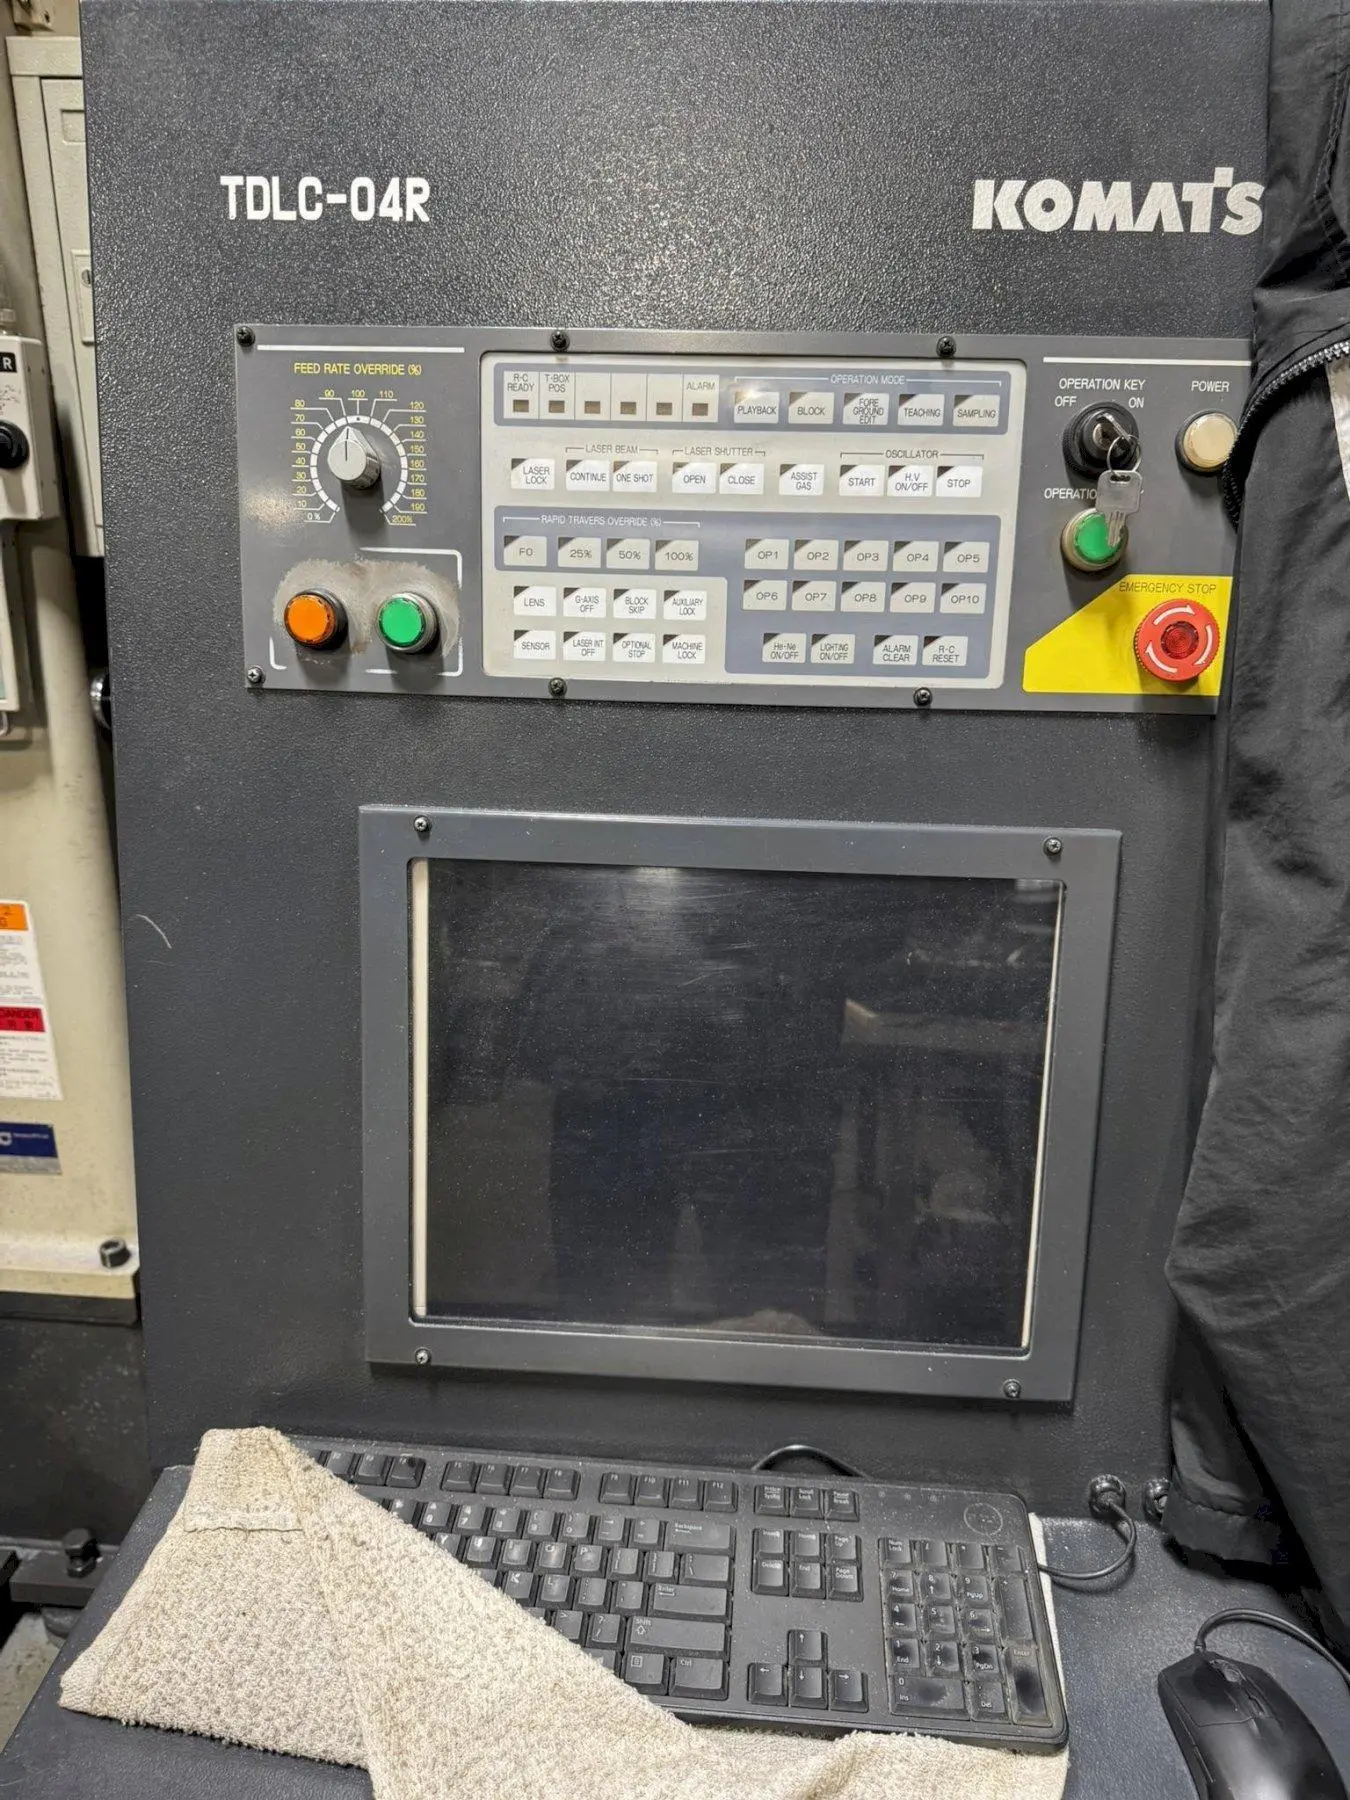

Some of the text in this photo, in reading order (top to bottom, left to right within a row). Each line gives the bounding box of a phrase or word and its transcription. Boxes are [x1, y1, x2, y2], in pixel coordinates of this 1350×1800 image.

[220, 175, 430, 222] TDLC-04R
[294, 363, 421, 375] FEED RATE OVERRIDE (%)
[513, 374, 528, 382] R-C
[545, 374, 570, 383] T-BOX
[831, 375, 904, 385] OPERATION MODE
[507, 383, 534, 392] READY
[549, 384, 565, 392] POS
[687, 382, 715, 390] ALARM
[1059, 379, 1146, 390] OPERATION KEY
[1192, 381, 1229, 392] POWER
[352, 390, 365, 398] 100
[295, 400, 305, 408] 80
[859, 398, 878, 407] FORE
[1055, 396, 1076, 407] OFF
[1129, 397, 1144, 408] ON
[738, 406, 776, 415] PLAYBACK
[798, 407, 824, 416] BLOCK
[853, 407, 884, 416] GROUND
[904, 408, 940, 417] TEACHING
[957, 409, 995, 418] SAMPLING
[295, 414, 305, 422] 70
[860, 415, 875, 424] EDIT
[586, 445, 638, 453] LASER BEAM
[685, 447, 752, 456] LASER SHUTTER
[885, 450, 938, 459] OSCILLATOR
[523, 467, 549, 475] LASER
[526, 475, 547, 484] LOCK
[570, 473, 606, 481] CONTINUE
[617, 474, 653, 482] ONE SHOT
[683, 475, 705, 484] OPEN
[791, 472, 817, 480] ASSIST
[728, 476, 755, 485] CLOSE
[848, 478, 874, 486] START
[947, 479, 970, 488] STOP
[796, 481, 811, 490] GAS
[895, 482, 928, 491] ON/OFF
[296, 486, 306, 494] 20
[411, 489, 424, 497] 180
[1044, 489, 1097, 499] OPERATIO
[541, 516, 661, 527] RAPID TRAVERS OVERRIDE (%)
[570, 550, 592, 558] 25%
[619, 551, 640, 559] 50%
[666, 552, 693, 561] 100%
[758, 551, 777, 559] OP1
[807, 552, 829, 561] OP2
[857, 553, 879, 562] OP3
[907, 554, 929, 562] OP4
[957, 554, 979, 563] OP5
[1119, 582, 1216, 594] EMERGENCY STOP
[756, 592, 777, 601] OP6
[805, 593, 826, 601] OP7
[855, 594, 876, 603] OP8
[904, 595, 926, 603] OP9
[951, 596, 979, 604] OP10
[524, 598, 545, 606] LENS
[625, 597, 648, 605] BLOCK
[672, 598, 702, 606] AUXILIARY
[580, 604, 594, 612] OFF
[628, 606, 644, 614] SKIP
[679, 607, 695, 615] LOCK
[522, 642, 549, 650] SENSOR
[622, 641, 651, 649] OPTIONAL
[672, 642, 702, 650] MACHINE
[820, 644, 848, 652] LIGHTING
[883, 645, 910, 653] ALARM
[582, 648, 595, 656] OFF
[628, 650, 645, 658] STOP
[939, 646, 954, 654] R-C
[678, 651, 696, 659] LOCK
[771, 652, 798, 660] ON/OFF
[820, 652, 848, 661] ON/OFF
[883, 654, 909, 662] CLEAR
[933, 655, 959, 663] RESET
[510, 1573, 521, 1583] K
[635, 1618, 651, 1626] Shift
